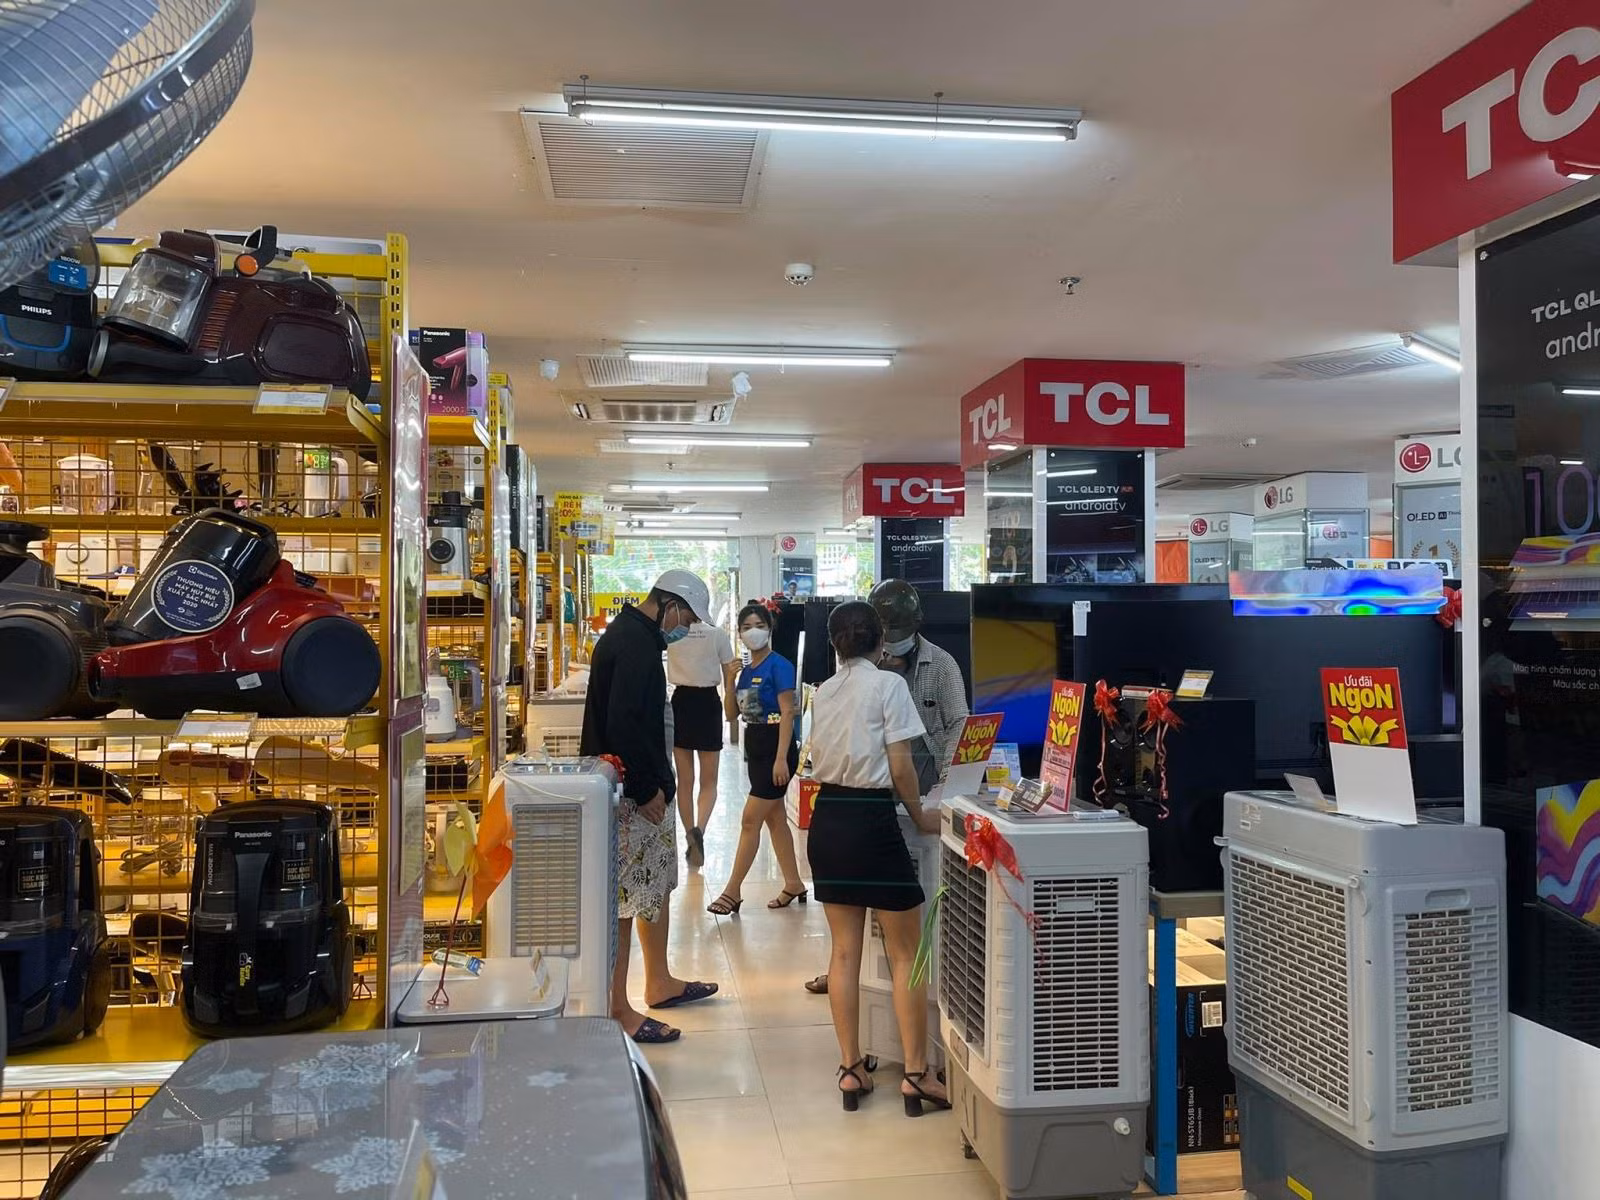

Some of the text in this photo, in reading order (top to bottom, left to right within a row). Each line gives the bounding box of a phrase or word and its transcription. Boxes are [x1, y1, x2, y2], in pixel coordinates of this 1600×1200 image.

[21, 304, 53, 316] PHILIPS
[1531, 300, 1571, 323] TCL
[1039, 381, 1170, 426] TCL
[969, 393, 1012, 445] TCL
[872, 477, 955, 504] TCL
[1057, 485, 1079, 493] TCL
[1080, 485, 1105, 493] QLED
[1279, 487, 1293, 504] LG
[1406, 512, 1436, 521] OLED
[1210, 520, 1229, 533] LG
[182, 600, 198, 608] 2020
[612, 593, 640, 605] ĐIỂM
[1344, 674, 1373, 687] Ưu đãi
[1053, 691, 1080, 718] NgoN
[1329, 682, 1394, 714] NgoN
[963, 722, 997, 742] NgoN
[234, 831, 272, 839] Panasonic
[1187, 991, 1196, 1034] INVERTER
